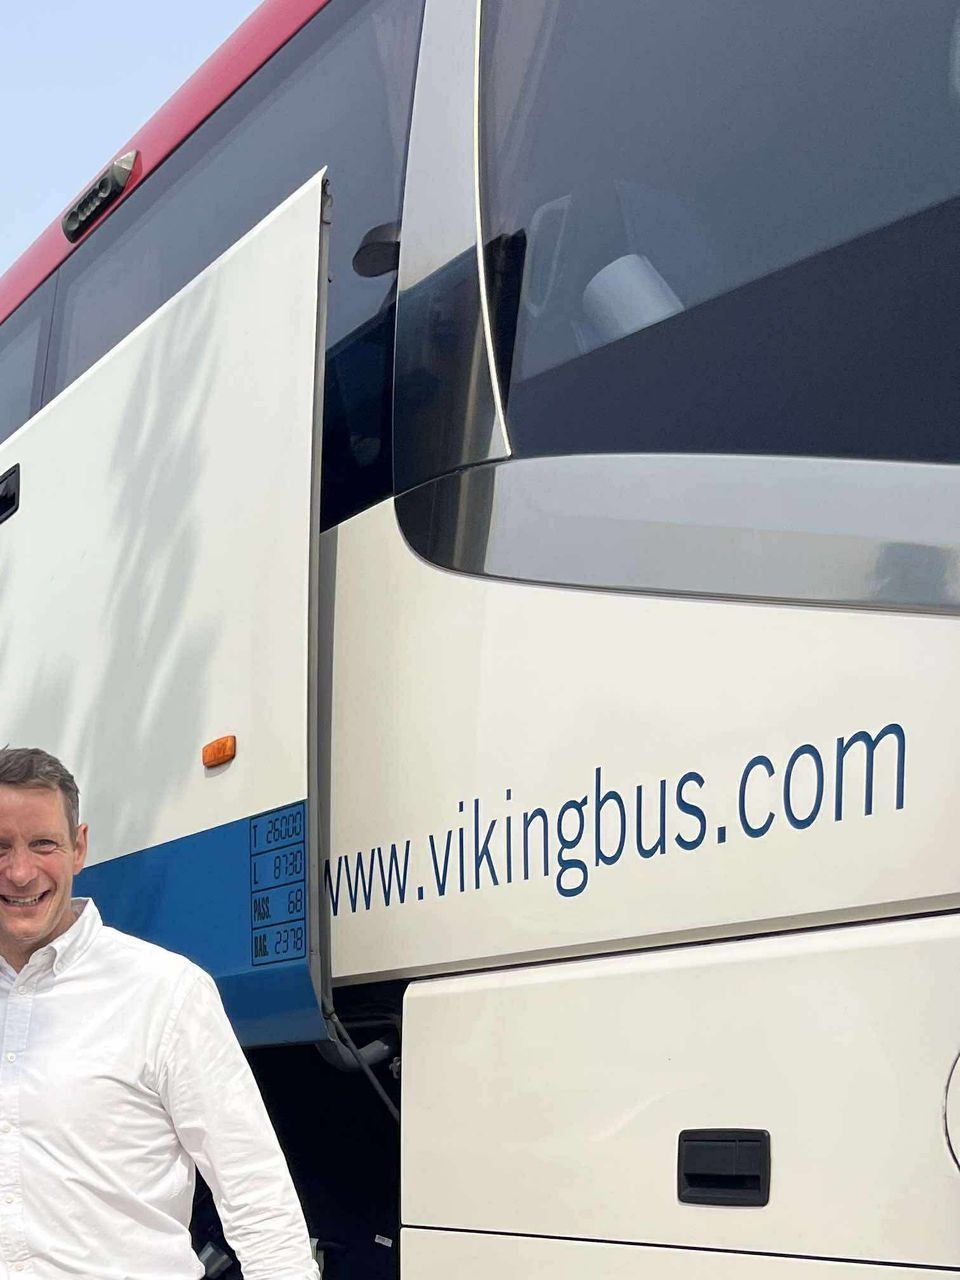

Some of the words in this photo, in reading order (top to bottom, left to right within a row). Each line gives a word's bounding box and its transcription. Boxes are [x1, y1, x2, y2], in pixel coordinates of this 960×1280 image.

[253, 825, 258, 848] T
[267, 812, 302, 844] 26000
[324, 722, 907, 917] www.vikingbus.com
[254, 863, 259, 885] L
[274, 850, 303, 880] 8730
[253, 897, 272, 921] PASS.
[288, 889, 303, 915] 68
[275, 928, 303, 954] 2378
